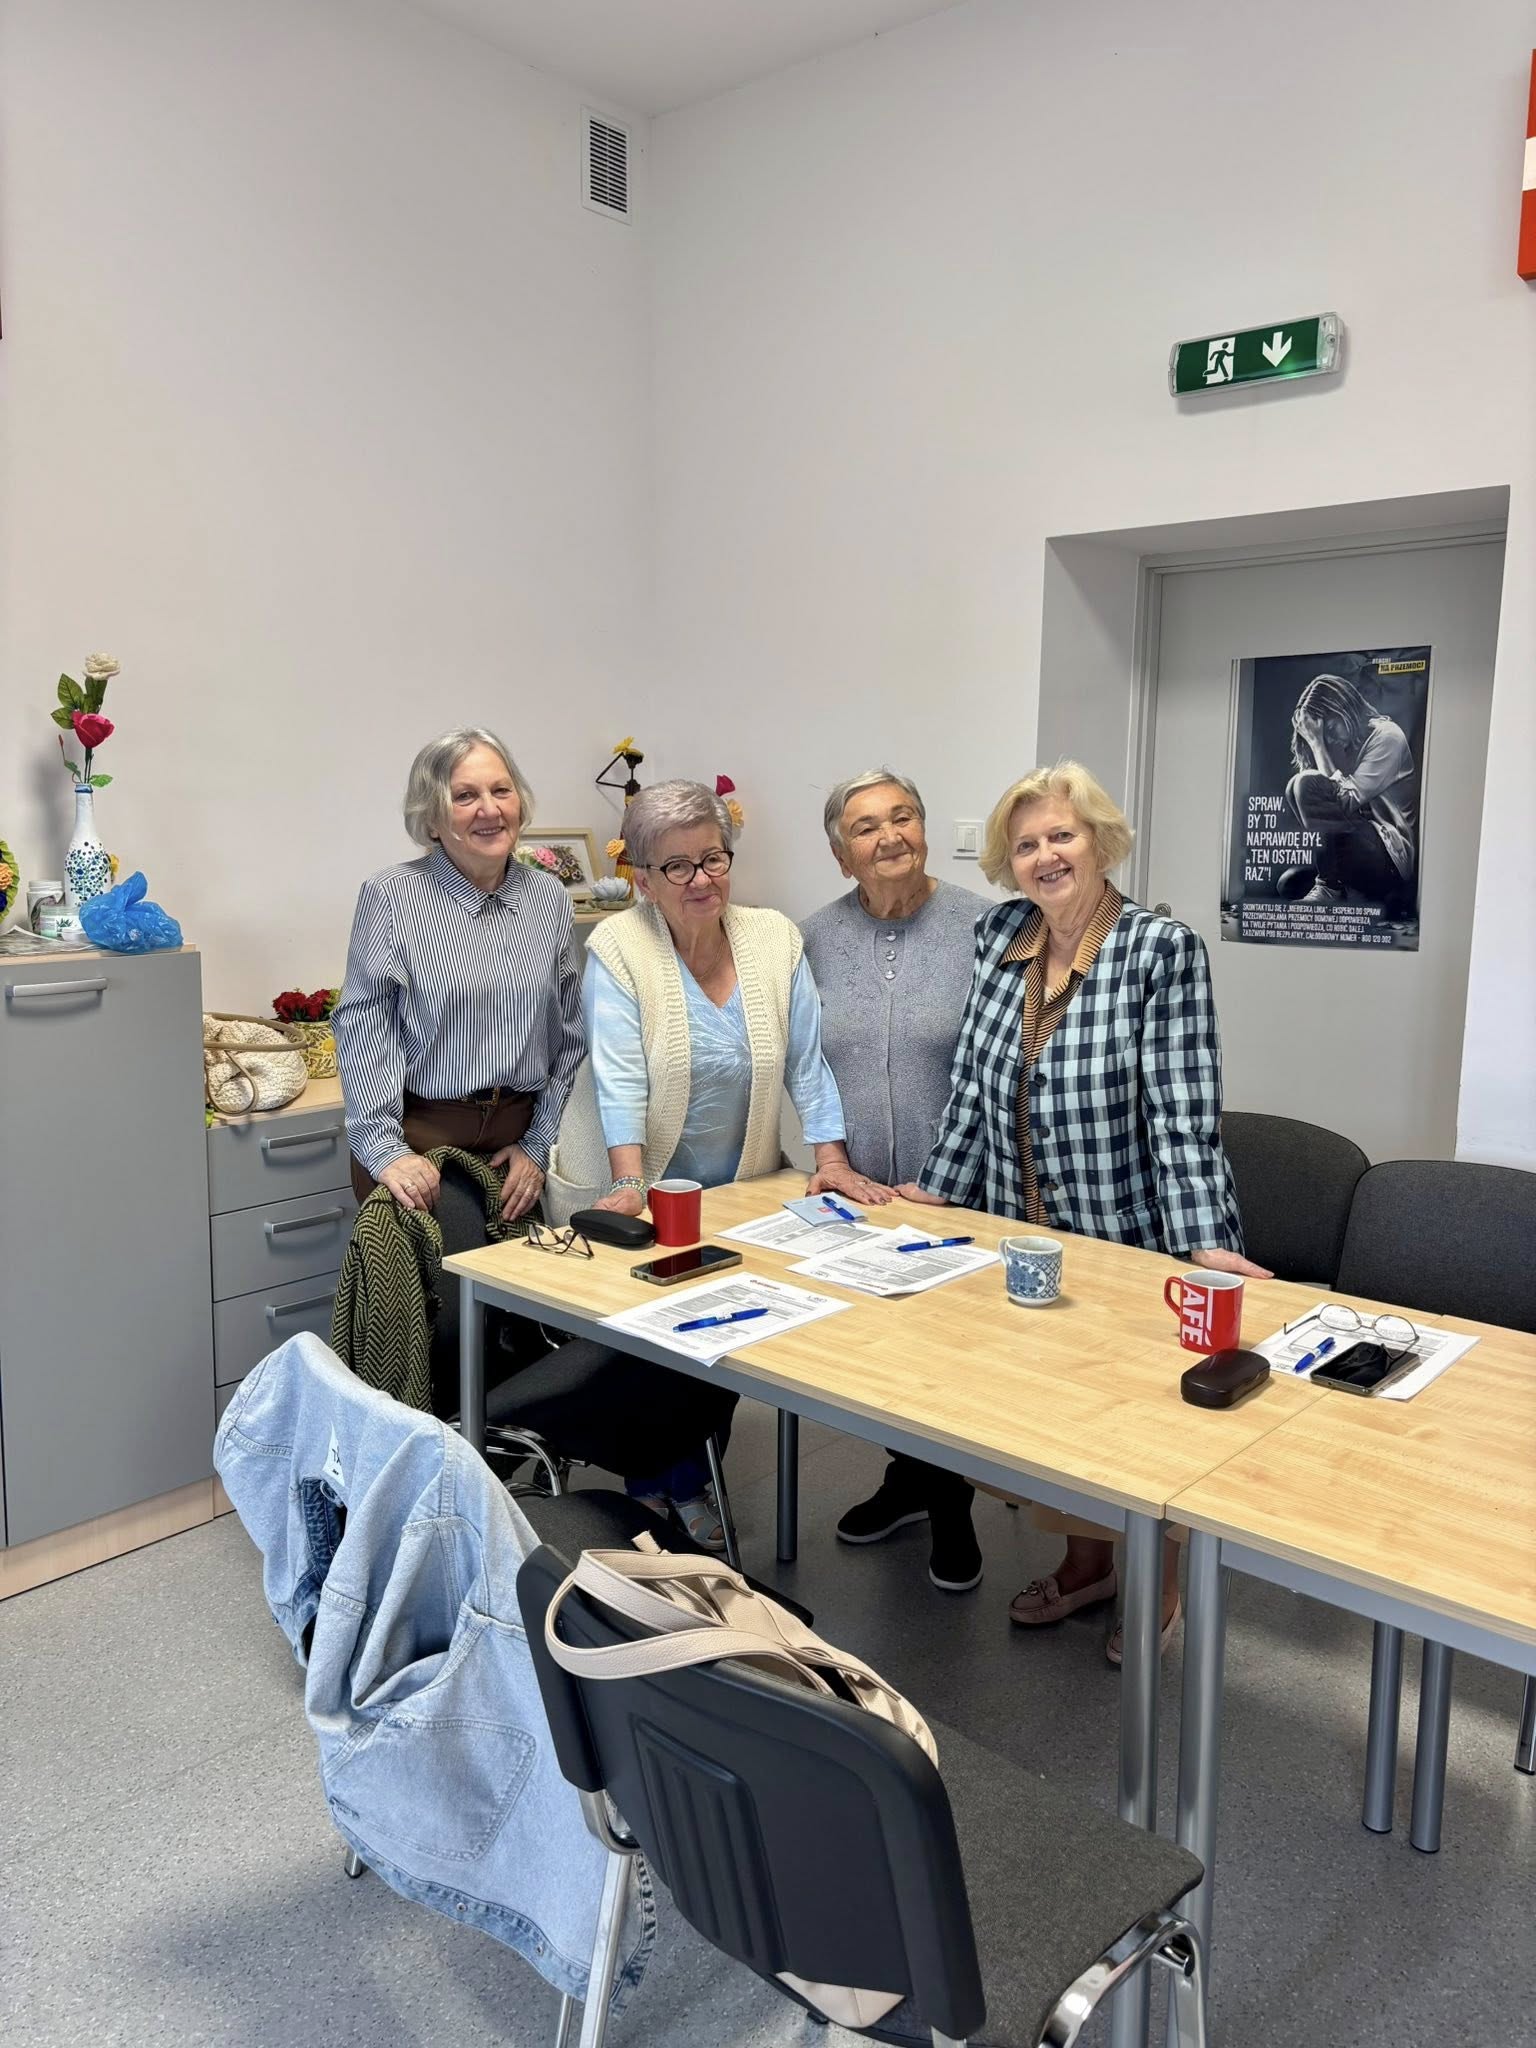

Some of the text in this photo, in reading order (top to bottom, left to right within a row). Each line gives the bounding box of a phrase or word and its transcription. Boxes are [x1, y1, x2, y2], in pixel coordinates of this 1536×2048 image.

[1248, 796, 1285, 813] SPRAW,
[1247, 814, 1277, 829] BY TO
[1246, 831, 1322, 849] NAPRAWDĘ BYŁ
[1246, 849, 1312, 865] „TEN OSTATNI
[1363, 908, 1381, 916] SPRAW
